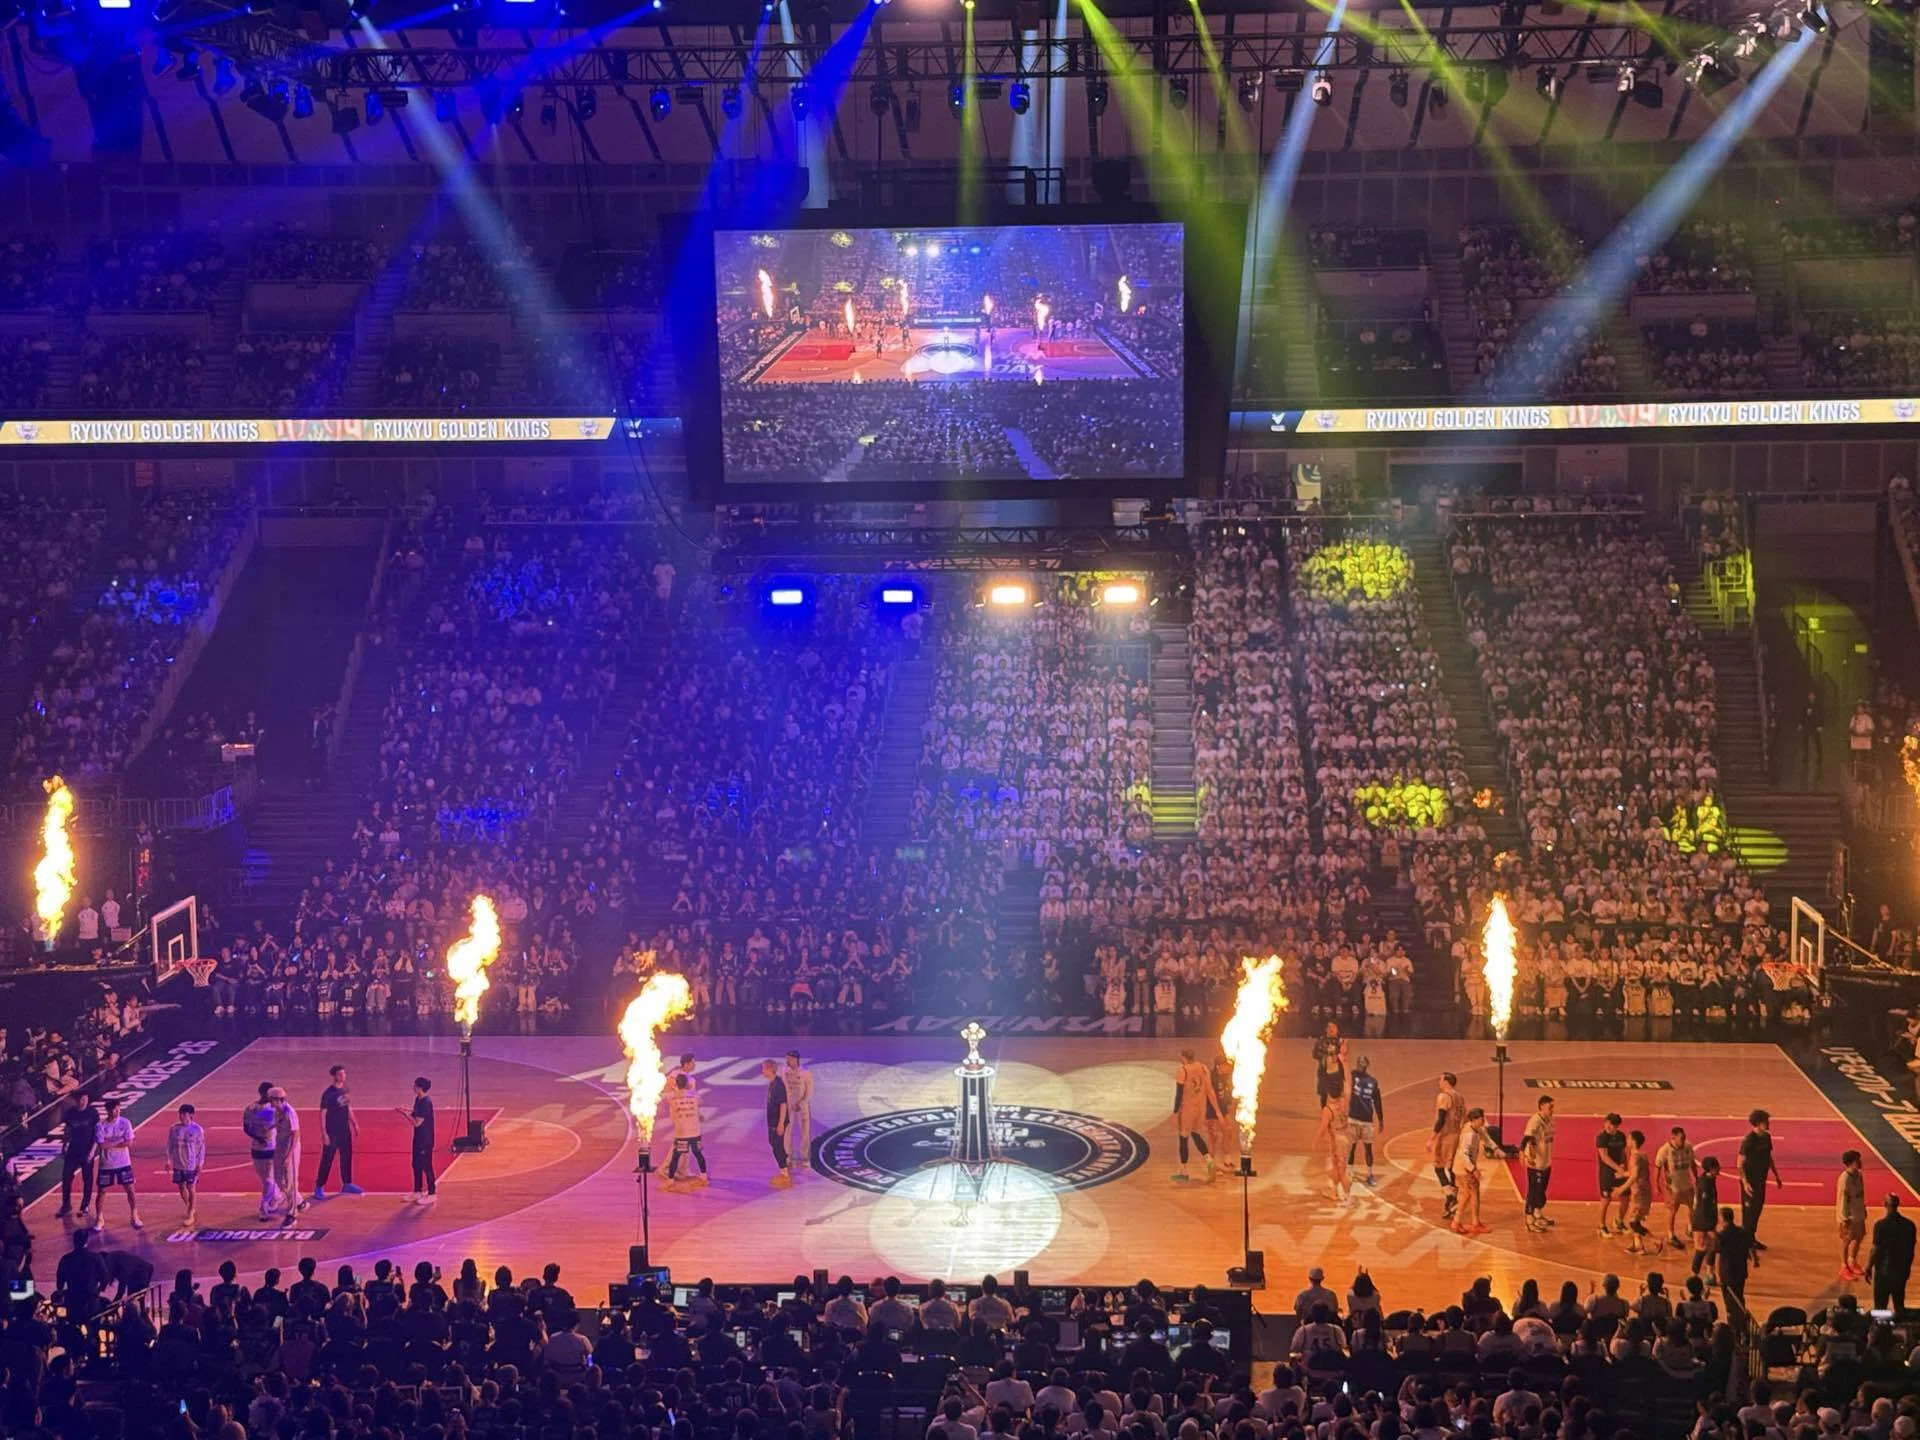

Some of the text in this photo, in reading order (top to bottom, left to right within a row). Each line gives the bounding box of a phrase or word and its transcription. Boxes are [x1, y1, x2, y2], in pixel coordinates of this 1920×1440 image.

[1367, 411, 1427, 429] RYUKYU
[1433, 410, 1495, 428] GOLDEN
[1501, 408, 1551, 427] KINGS
[1668, 404, 1731, 424] RYUKYU
[1738, 403, 1801, 423] GOLDEN
[1809, 402, 1860, 421] KINGS
[71, 422, 133, 441] RYUKYU
[141, 422, 203, 440] GOLDEN
[210, 421, 259, 440] KINGS
[373, 421, 432, 439] RYUKYU
[438, 421, 497, 438] GOLDEN
[504, 420, 550, 438] KINGS
[117, 1040, 219, 1098] 2025-26
[838, 1112, 960, 1148] ANNIVERSAR
[199, 1230, 316, 1241] B.LEAGUE
